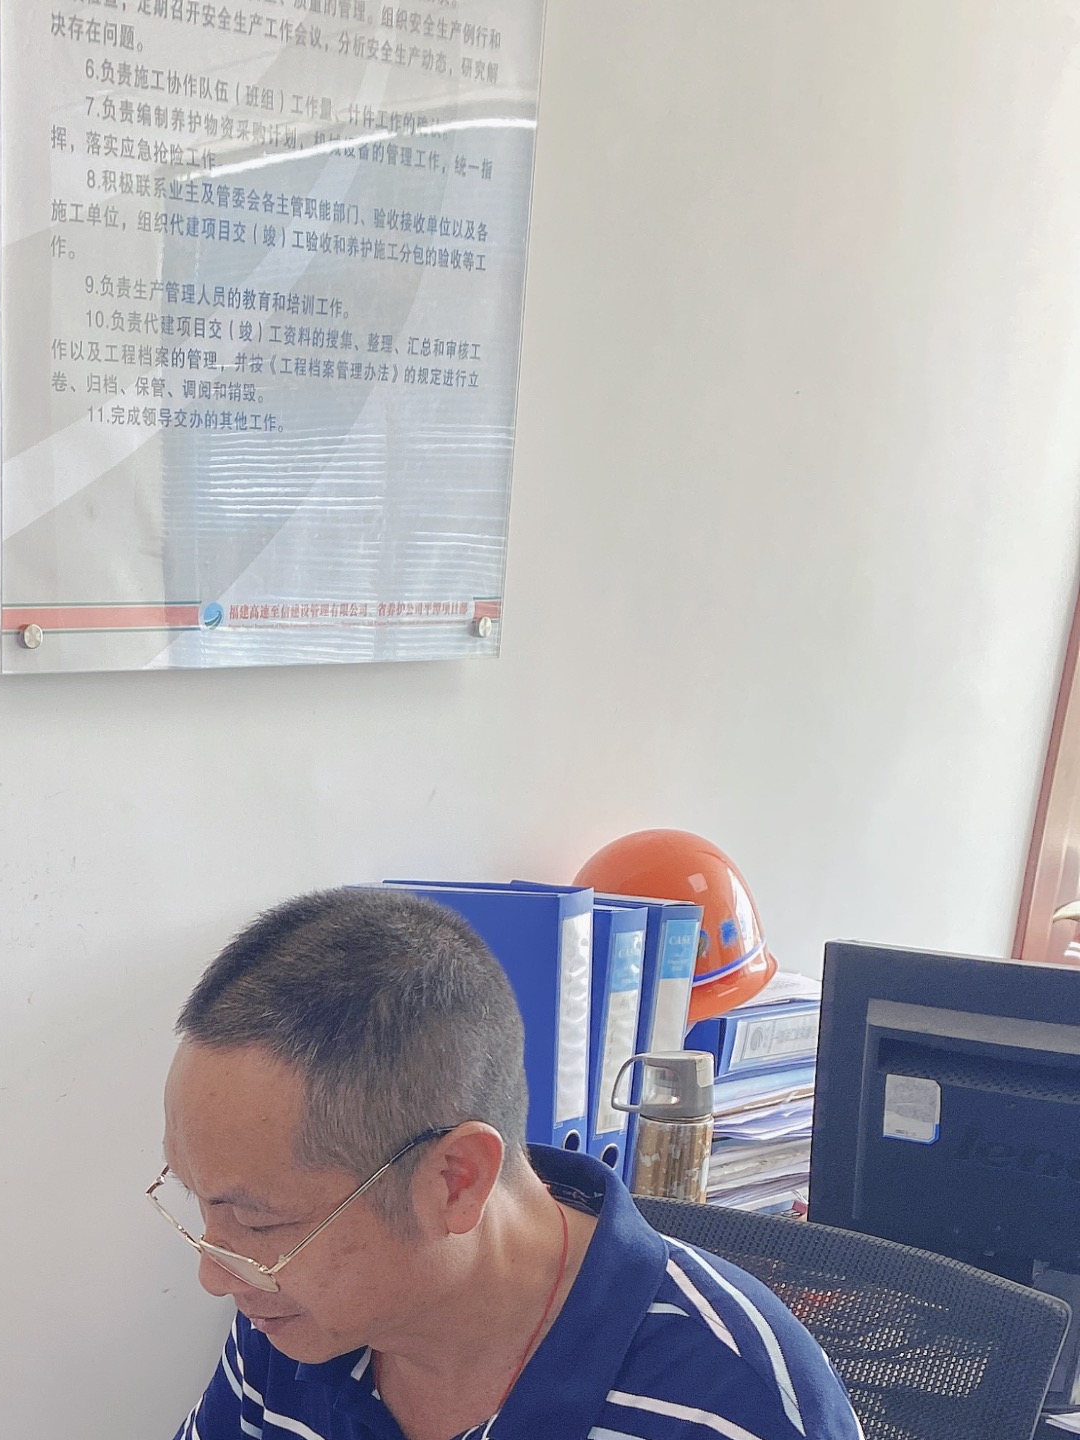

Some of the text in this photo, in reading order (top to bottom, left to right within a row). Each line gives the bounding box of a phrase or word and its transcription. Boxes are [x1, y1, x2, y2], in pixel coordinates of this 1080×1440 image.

[51, 12, 143, 52] 决存在问题。
[51, 235, 77, 260] 作。
[85, 274, 351, 319] 9.负责生产管理人员的教育和培训工作。
[86, 405, 285, 433] 11.完成领导交办的其他工作。
